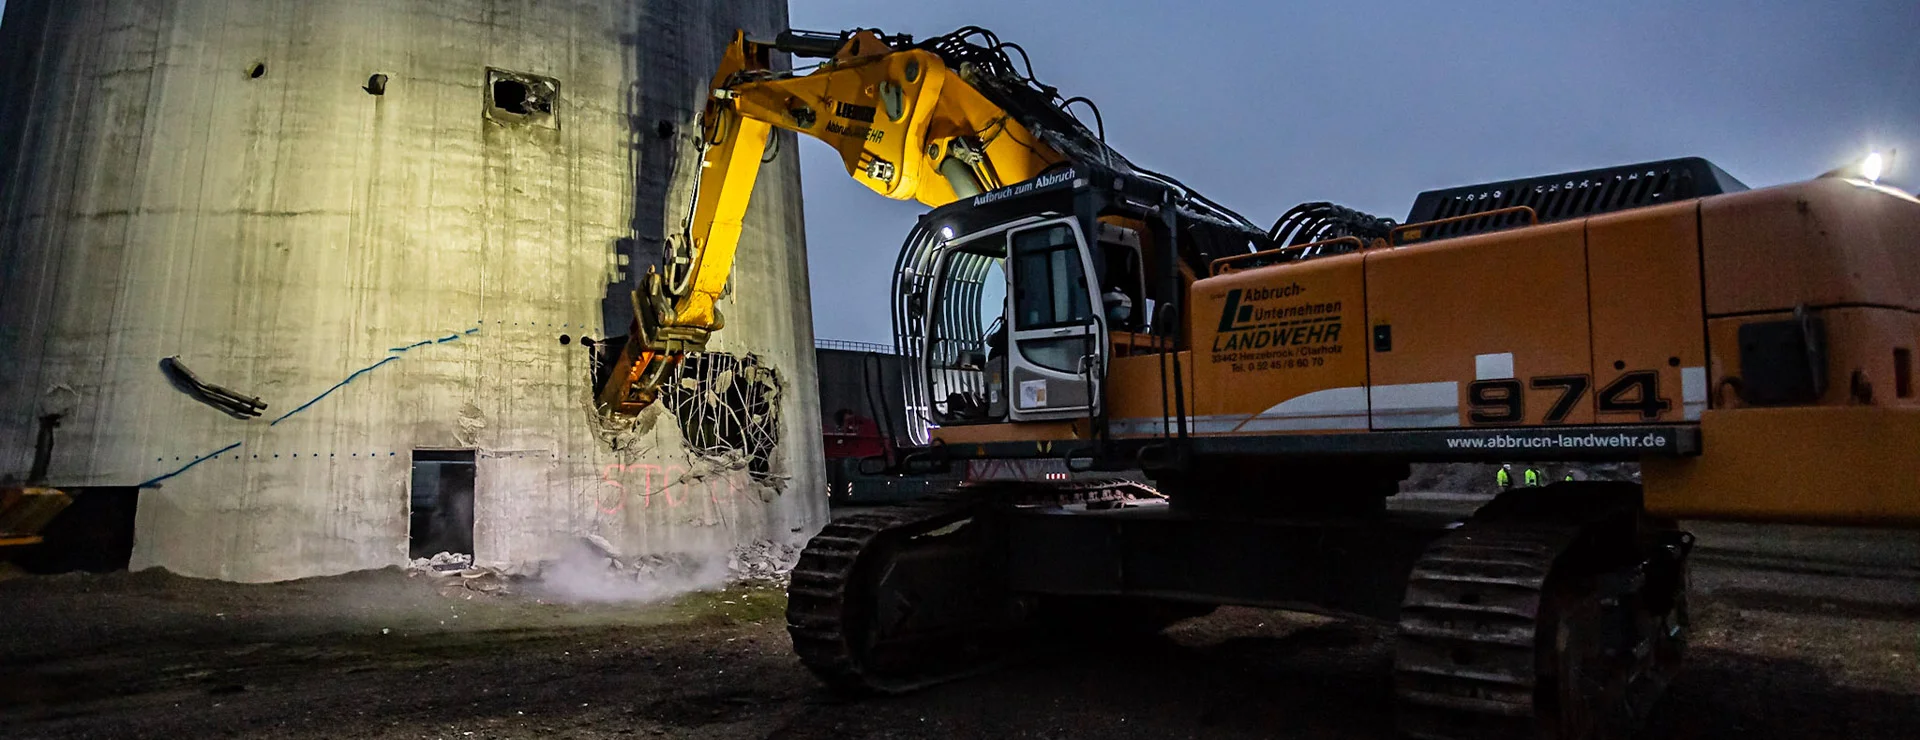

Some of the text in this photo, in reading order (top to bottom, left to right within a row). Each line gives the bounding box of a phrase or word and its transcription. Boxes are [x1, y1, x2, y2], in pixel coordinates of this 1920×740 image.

[973, 168, 1076, 207] Aufbruch zum Abbruch
[1244, 282, 1306, 302] Abbruch-
[1255, 301, 1342, 320] Unternehmen
[1211, 323, 1342, 353] LANDWEHR
[1248, 362, 1255, 372] 0
[1257, 361, 1268, 371] 52
[1311, 357, 1324, 367] 70
[1467, 369, 1672, 424] 974
